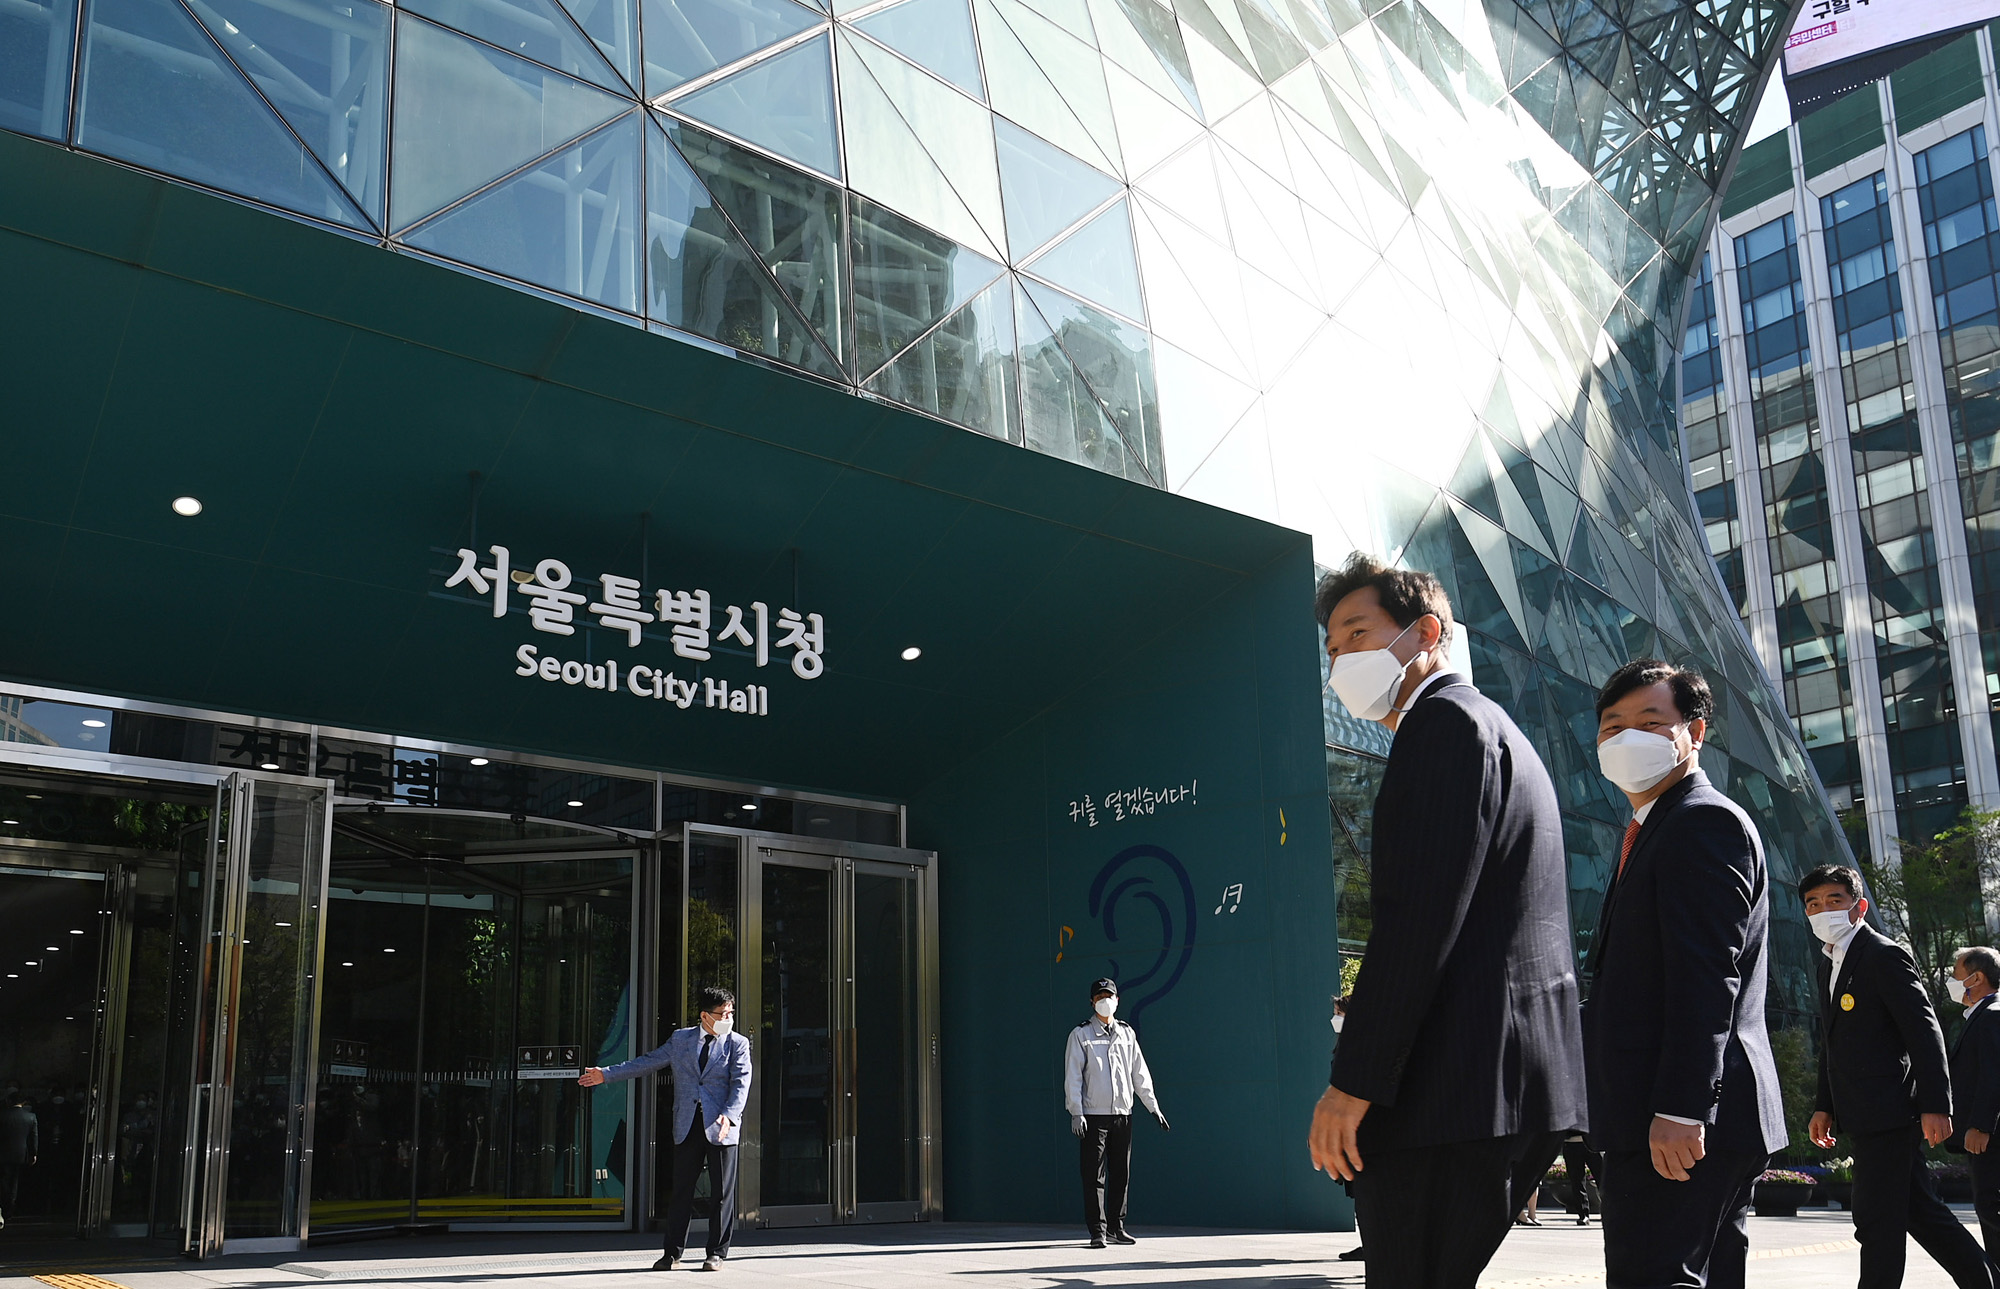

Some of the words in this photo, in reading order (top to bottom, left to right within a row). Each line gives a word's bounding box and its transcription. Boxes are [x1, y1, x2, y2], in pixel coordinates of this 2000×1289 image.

[445, 545, 825, 680] 서울특별시청
[515, 644, 618, 692] Seoul
[627, 665, 698, 709] City
[703, 677, 769, 716] Hall
[1069, 795, 1099, 827] 귀를
[1104, 779, 1197, 821] 열겠습니다!
